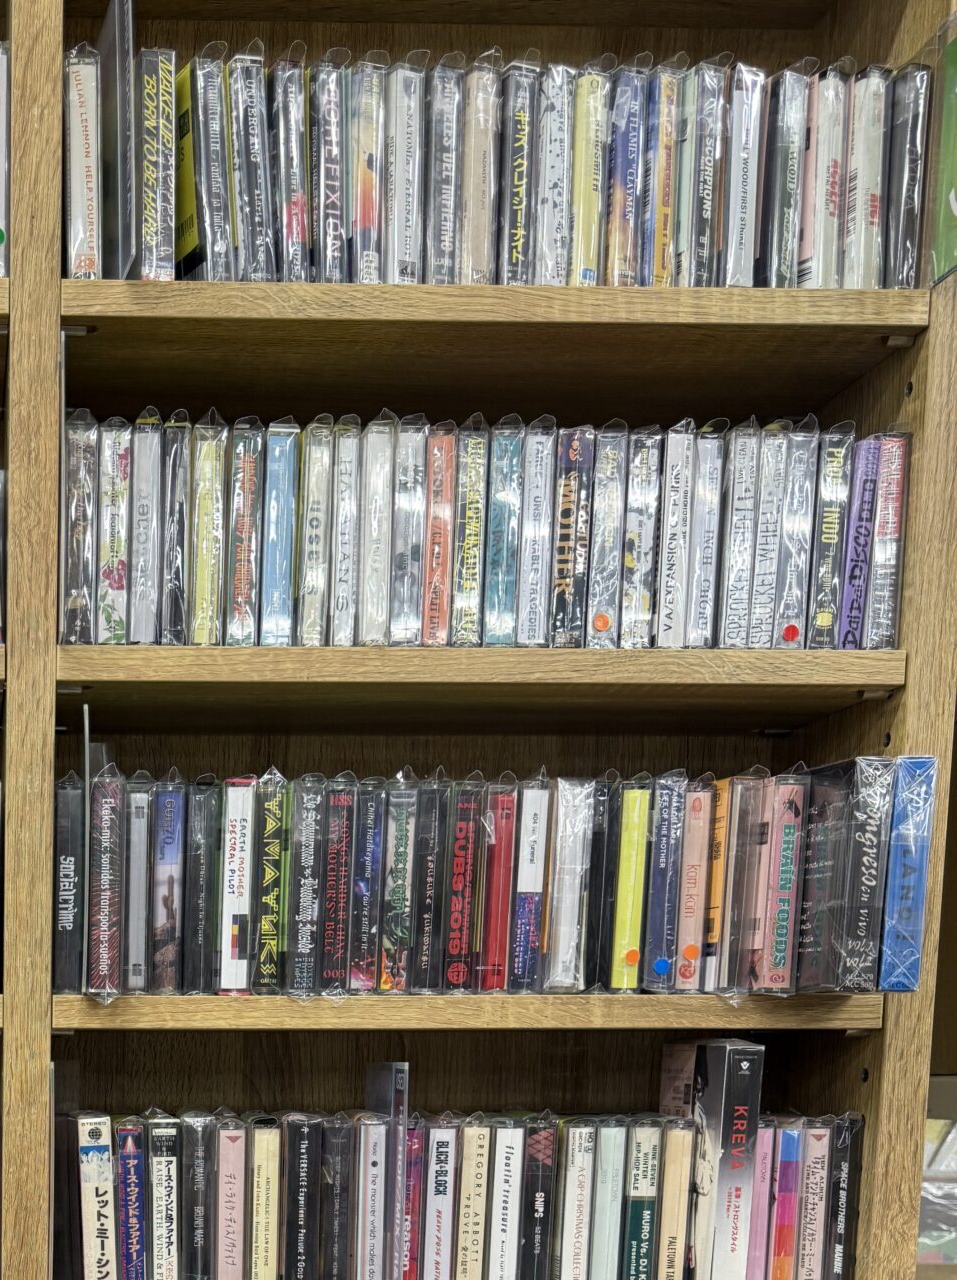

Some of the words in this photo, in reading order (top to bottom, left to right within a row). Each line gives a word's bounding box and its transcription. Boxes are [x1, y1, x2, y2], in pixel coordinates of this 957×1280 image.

[72, 70, 84, 108] JULIAN
[79, 111, 91, 159] LENNON
[84, 165, 93, 193] HELP
[703, 137, 713, 220] SCORPIONS
[85, 197, 96, 256] YOURSELF
[229, 818, 237, 865] SPECTRAL
[239, 818, 247, 852] EARTH
[452, 821, 467, 892] DUBS
[659, 837, 667, 868] MOTHER
[101, 854, 111, 889] sonidos
[228, 869, 236, 894] PILOT
[237, 857, 245, 897] MOTHER
[448, 896, 465, 956] 2019
[773, 897, 791, 968] FOODS
[300, 1140, 308, 1152] The
[730, 1105, 748, 1170] KREVA
[299, 1155, 308, 1185] VERSACE
[474, 1134, 485, 1199] GREGORY
[633, 1142, 642, 1171] HIP-HOP
[649, 1145, 657, 1187] NINE-SEVEN
[632, 1173, 640, 1191] SALE
[840, 1161, 849, 1189] SPACE
[297, 1189, 307, 1224] Experience
[369, 1189, 377, 1219] monster
[500, 1190, 510, 1233] treasure
[534, 1192, 545, 1217] SNIPS
[574, 1194, 585, 1239] CHRISTMAS
[837, 1190, 847, 1234] BROTHERS
[369, 1223, 377, 1240] which
[471, 1212, 480, 1263] ABBOTT
[641, 1210, 651, 1240] MURO
[156, 1234, 164, 1260] WIND
[368, 1243, 376, 1266] makes
[629, 1241, 637, 1275] presented
[666, 1236, 677, 1269] PALETOWN
[639, 1259, 648, 1271] DJ
